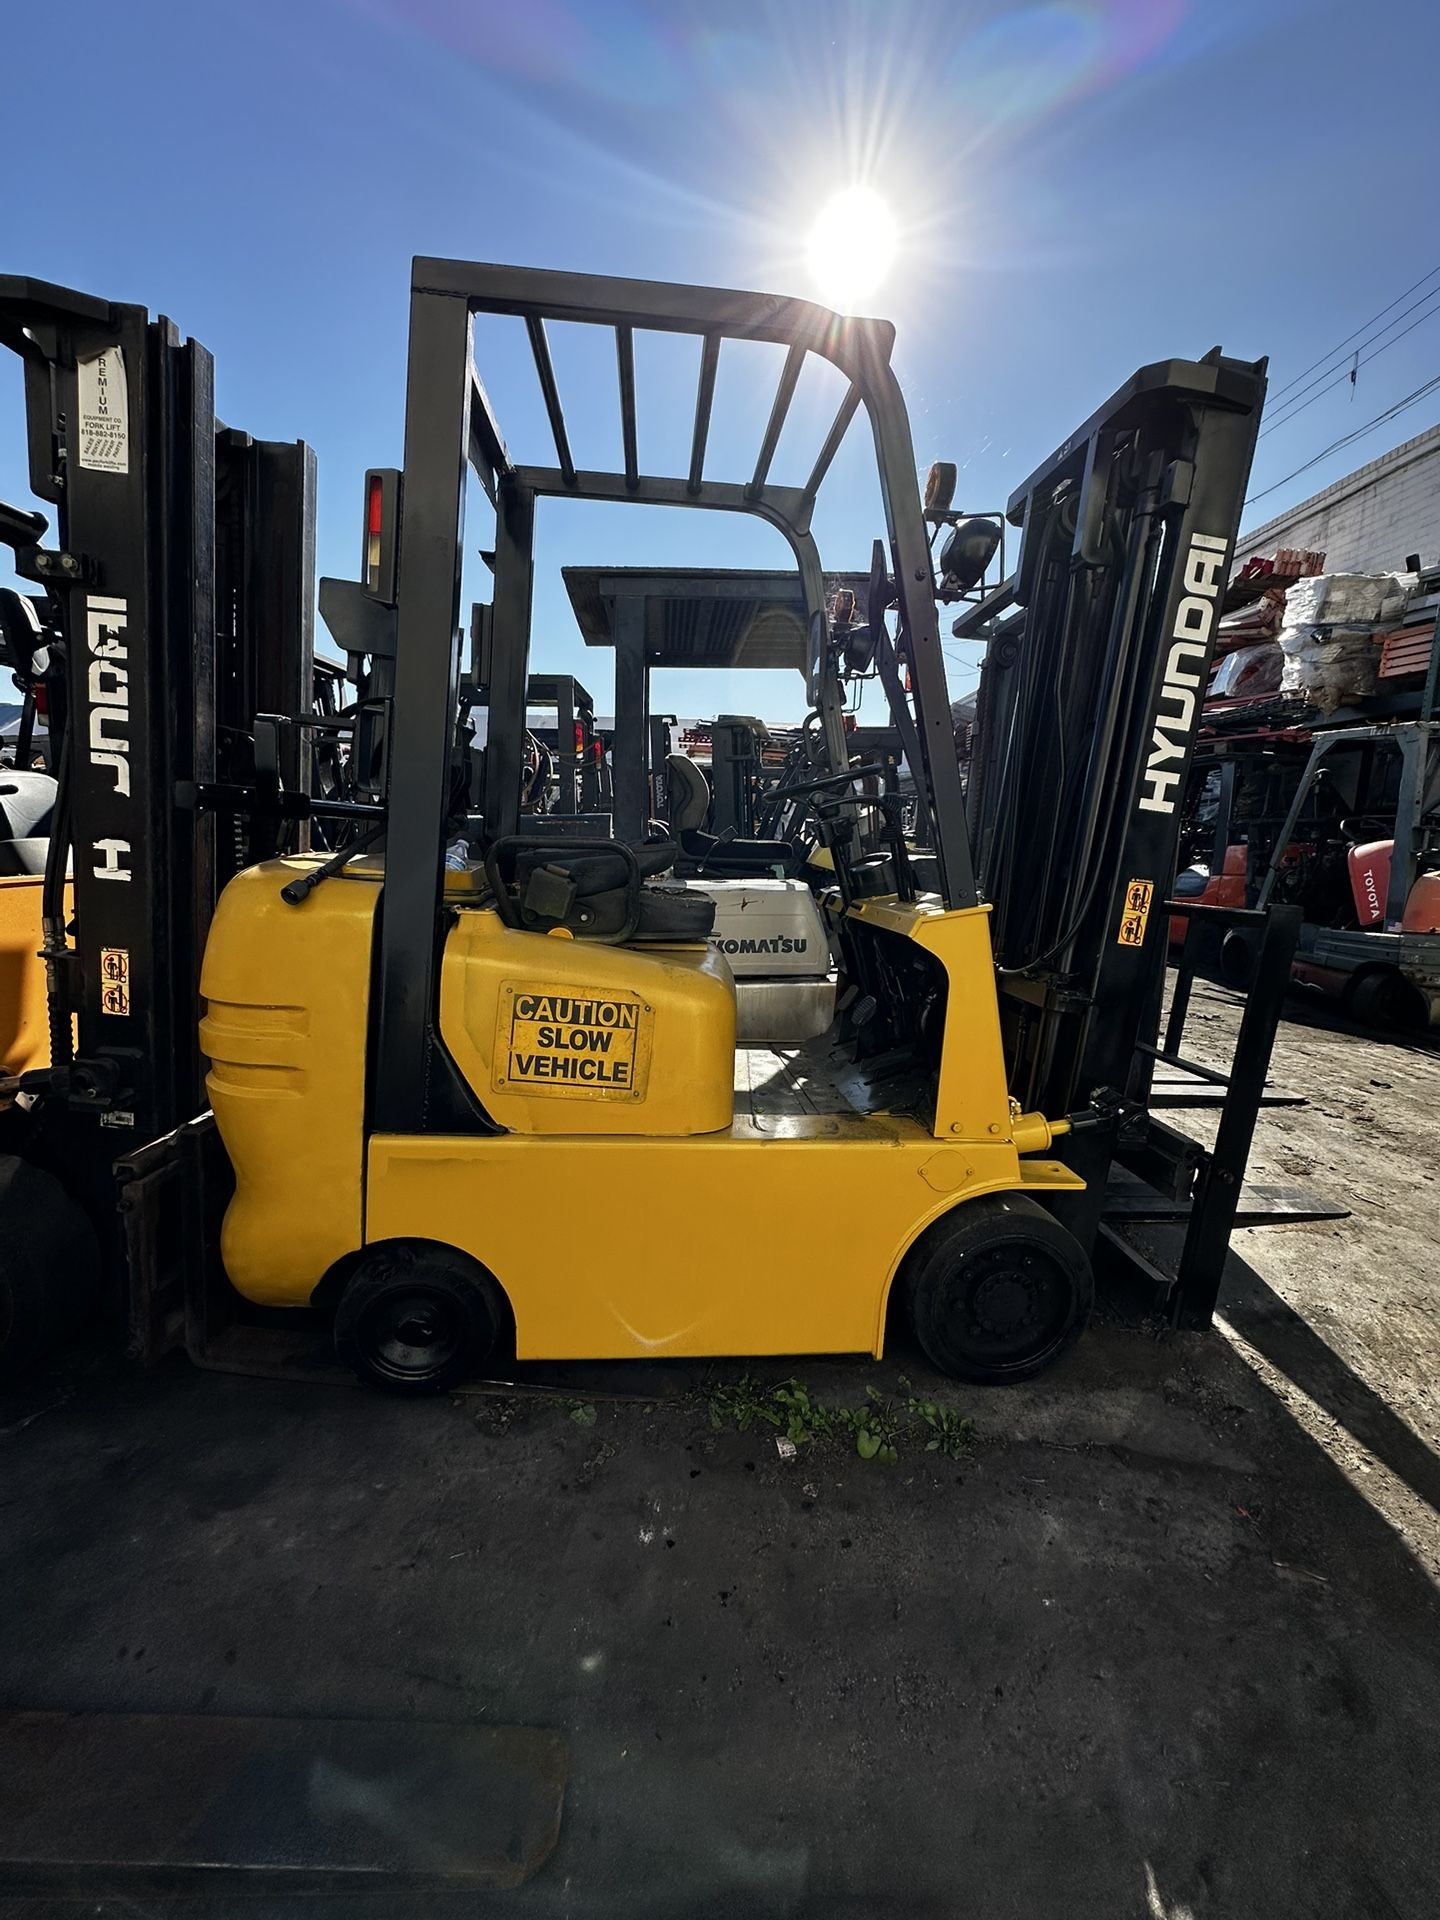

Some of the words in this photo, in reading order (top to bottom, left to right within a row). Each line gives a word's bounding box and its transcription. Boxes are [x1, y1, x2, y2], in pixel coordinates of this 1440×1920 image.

[85, 421, 105, 430] FORK
[106, 423, 121, 431] LIFT
[83, 437, 95, 455] SALES
[90, 438, 103, 457] RENTAL
[98, 439, 109, 457] SERVICE
[104, 439, 116, 458] REPAIR
[112, 440, 123, 458] PARTS
[1138, 532, 1229, 814] HYUNDAI
[655, 773, 664, 809] TOYOTA
[1363, 869, 1381, 919] TOYOTA
[516, 996, 638, 1028] CAUTION
[537, 1026, 613, 1053] SLOW
[515, 1053, 629, 1083] VEHICLE
